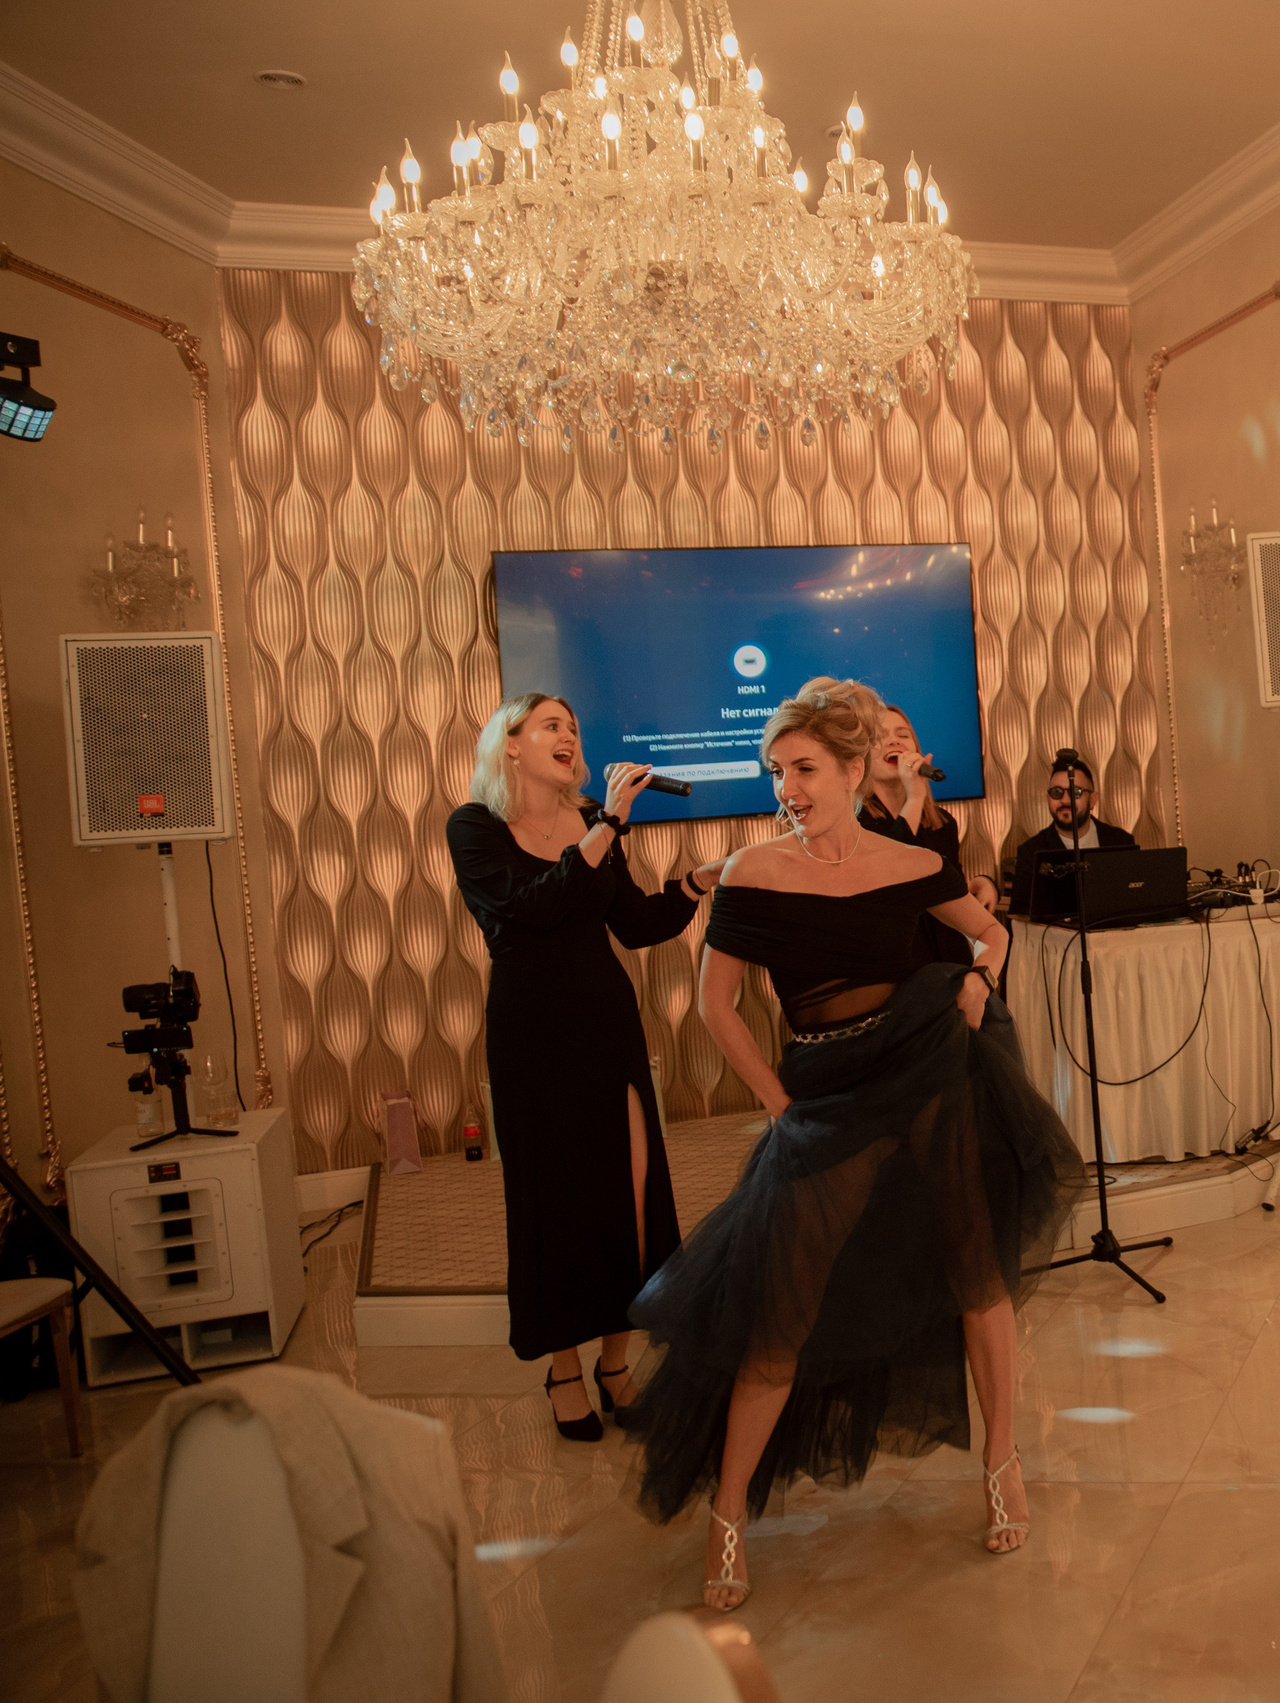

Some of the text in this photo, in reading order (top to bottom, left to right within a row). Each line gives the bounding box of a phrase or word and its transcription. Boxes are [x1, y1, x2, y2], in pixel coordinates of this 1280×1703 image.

[737, 684, 766, 694] HDMI 1
[721, 707, 778, 718] Нет сигнал
[623, 735, 631, 743] (1)
[631, 733, 662, 742] Проверьте
[697, 767, 750, 776] подключению
